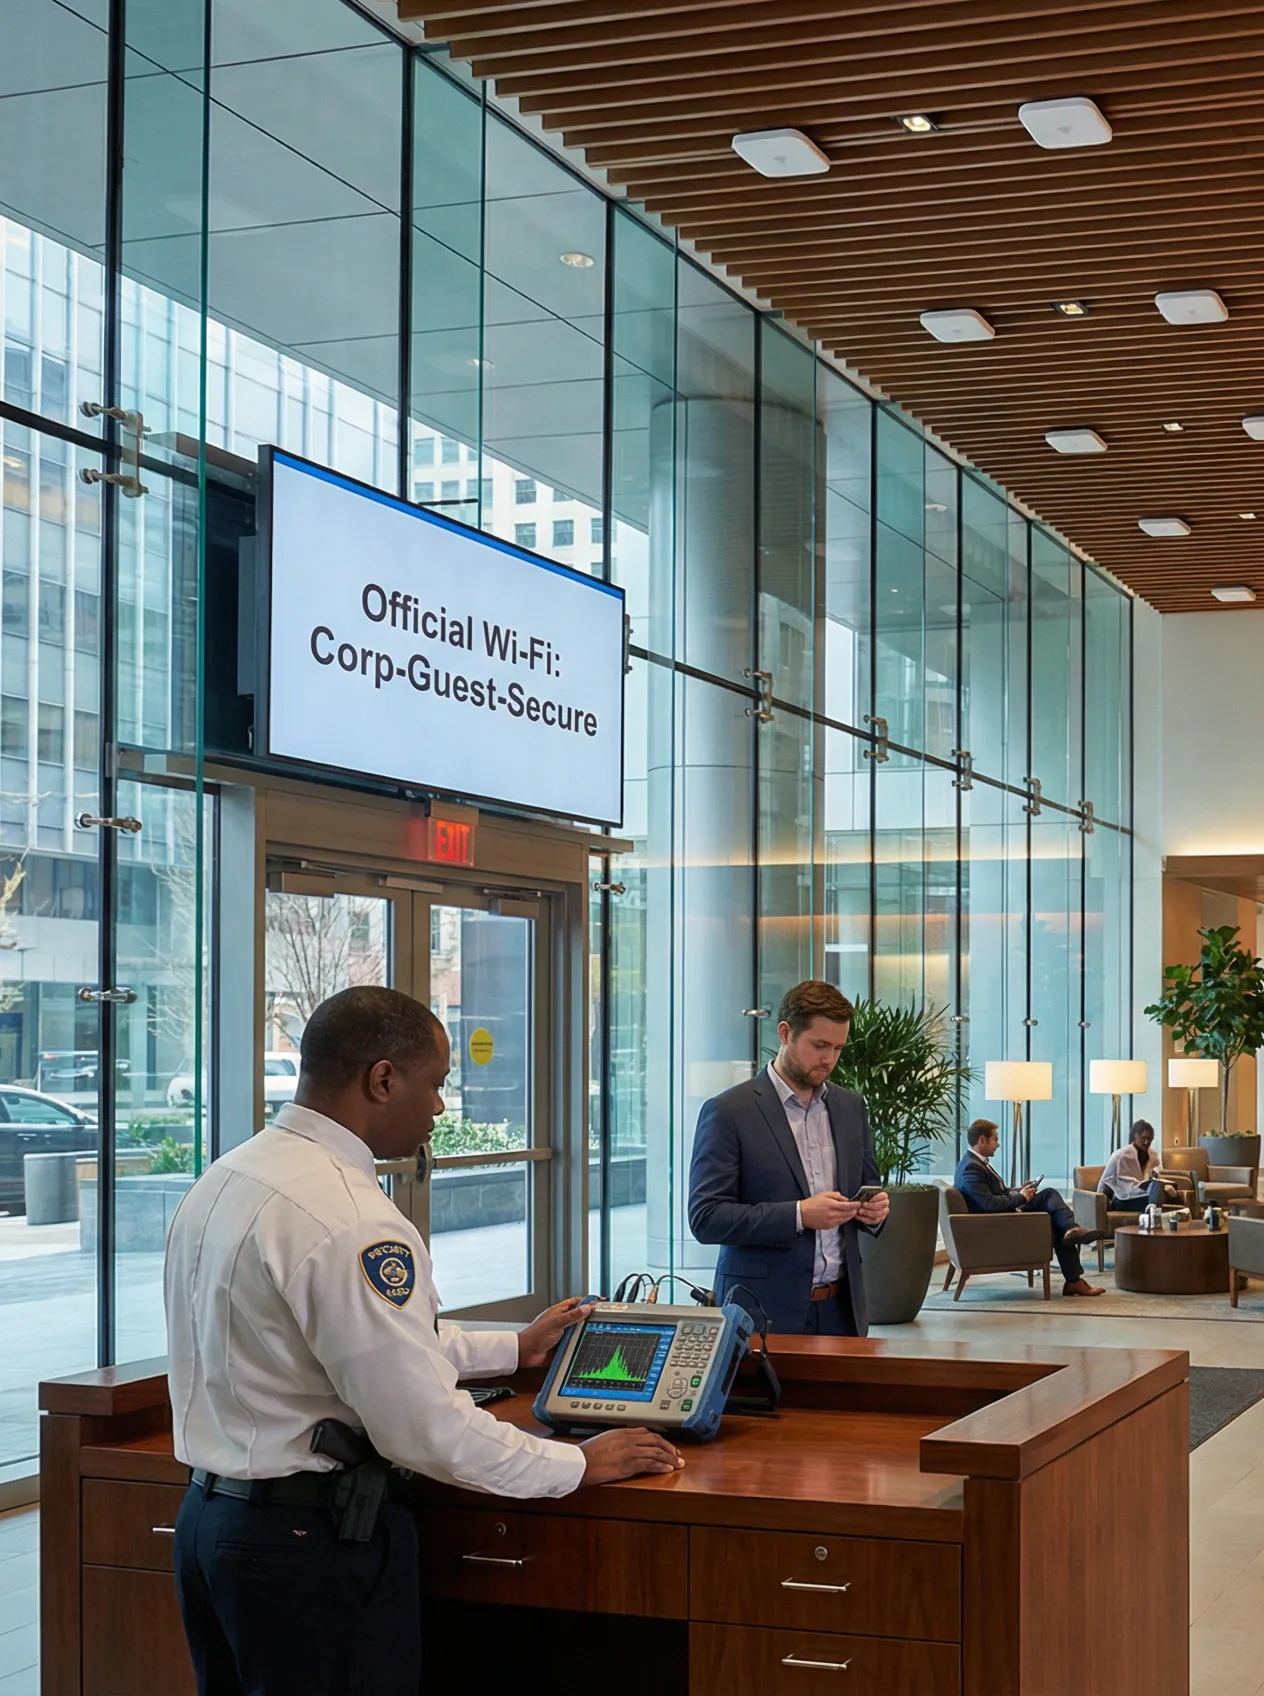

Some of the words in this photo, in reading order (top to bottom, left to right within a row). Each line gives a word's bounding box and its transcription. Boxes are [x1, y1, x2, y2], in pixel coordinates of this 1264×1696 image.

[310, 625, 598, 737] Corp-Guest-Secure
[361, 583, 473, 651] Official
[482, 620, 561, 677] Wi-Fi:
